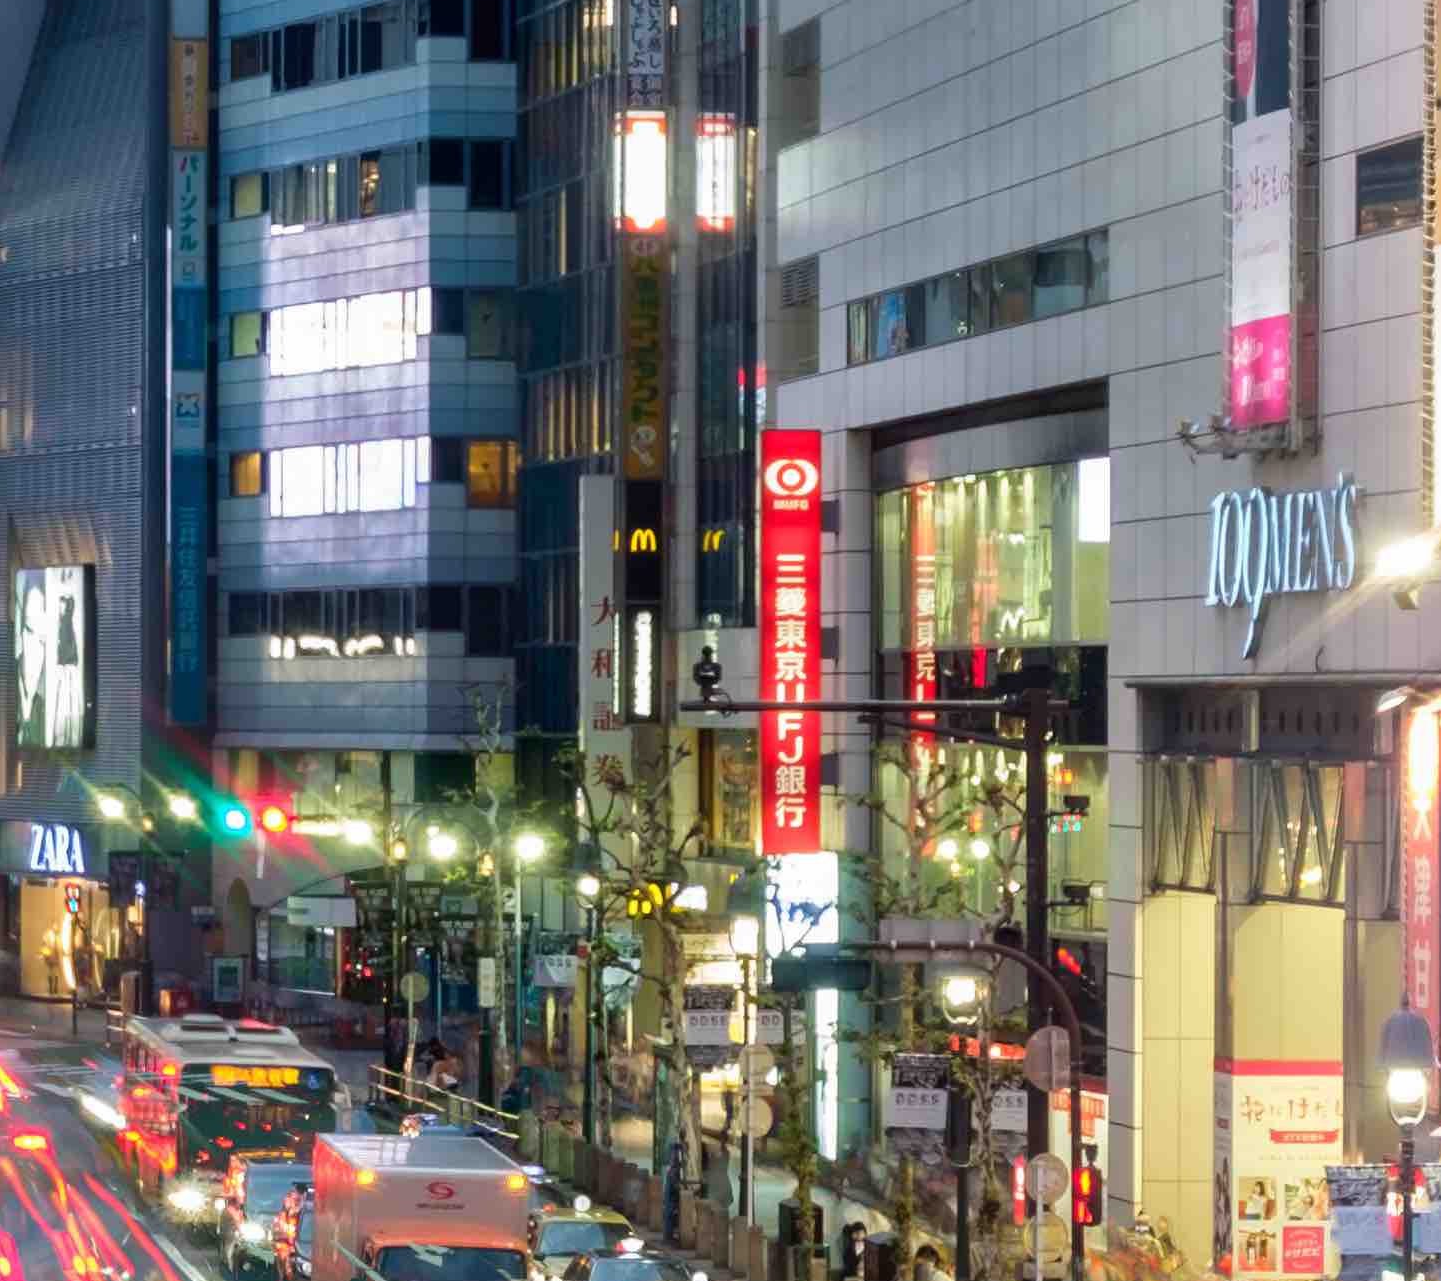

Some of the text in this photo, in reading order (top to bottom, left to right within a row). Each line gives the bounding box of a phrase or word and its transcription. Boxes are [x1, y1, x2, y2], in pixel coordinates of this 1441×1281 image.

[775, 552, 809, 830] 三菱東京UFJ銀行
[30, 825, 86, 875] ZARA
